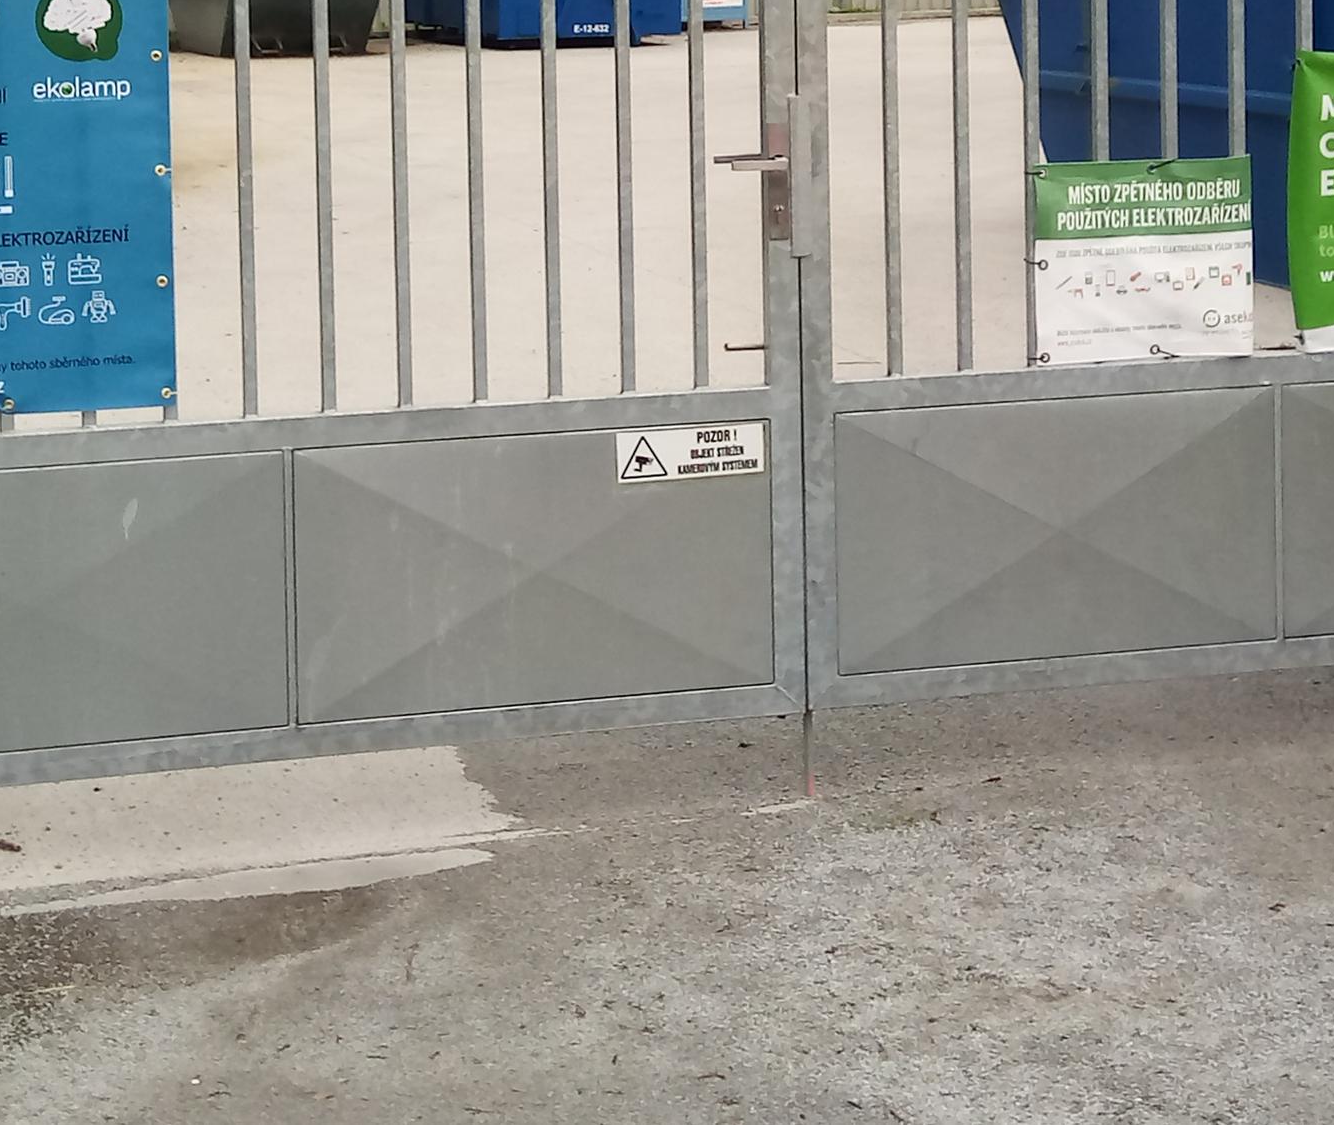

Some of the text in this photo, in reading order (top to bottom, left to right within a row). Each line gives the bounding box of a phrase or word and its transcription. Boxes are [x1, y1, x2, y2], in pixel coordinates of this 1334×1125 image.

[33, 76, 131, 100] ekolamp
[1068, 178, 1240, 204] MÍSTO ZPĚTNÉHO ODBĚRU
[1057, 201, 1251, 230] POUŽITÝCH ELEKTROZAŘÍZENÍ
[10, 360, 47, 371] tohoto
[49, 356, 100, 370] sběrného
[696, 430, 730, 444] POZOR
